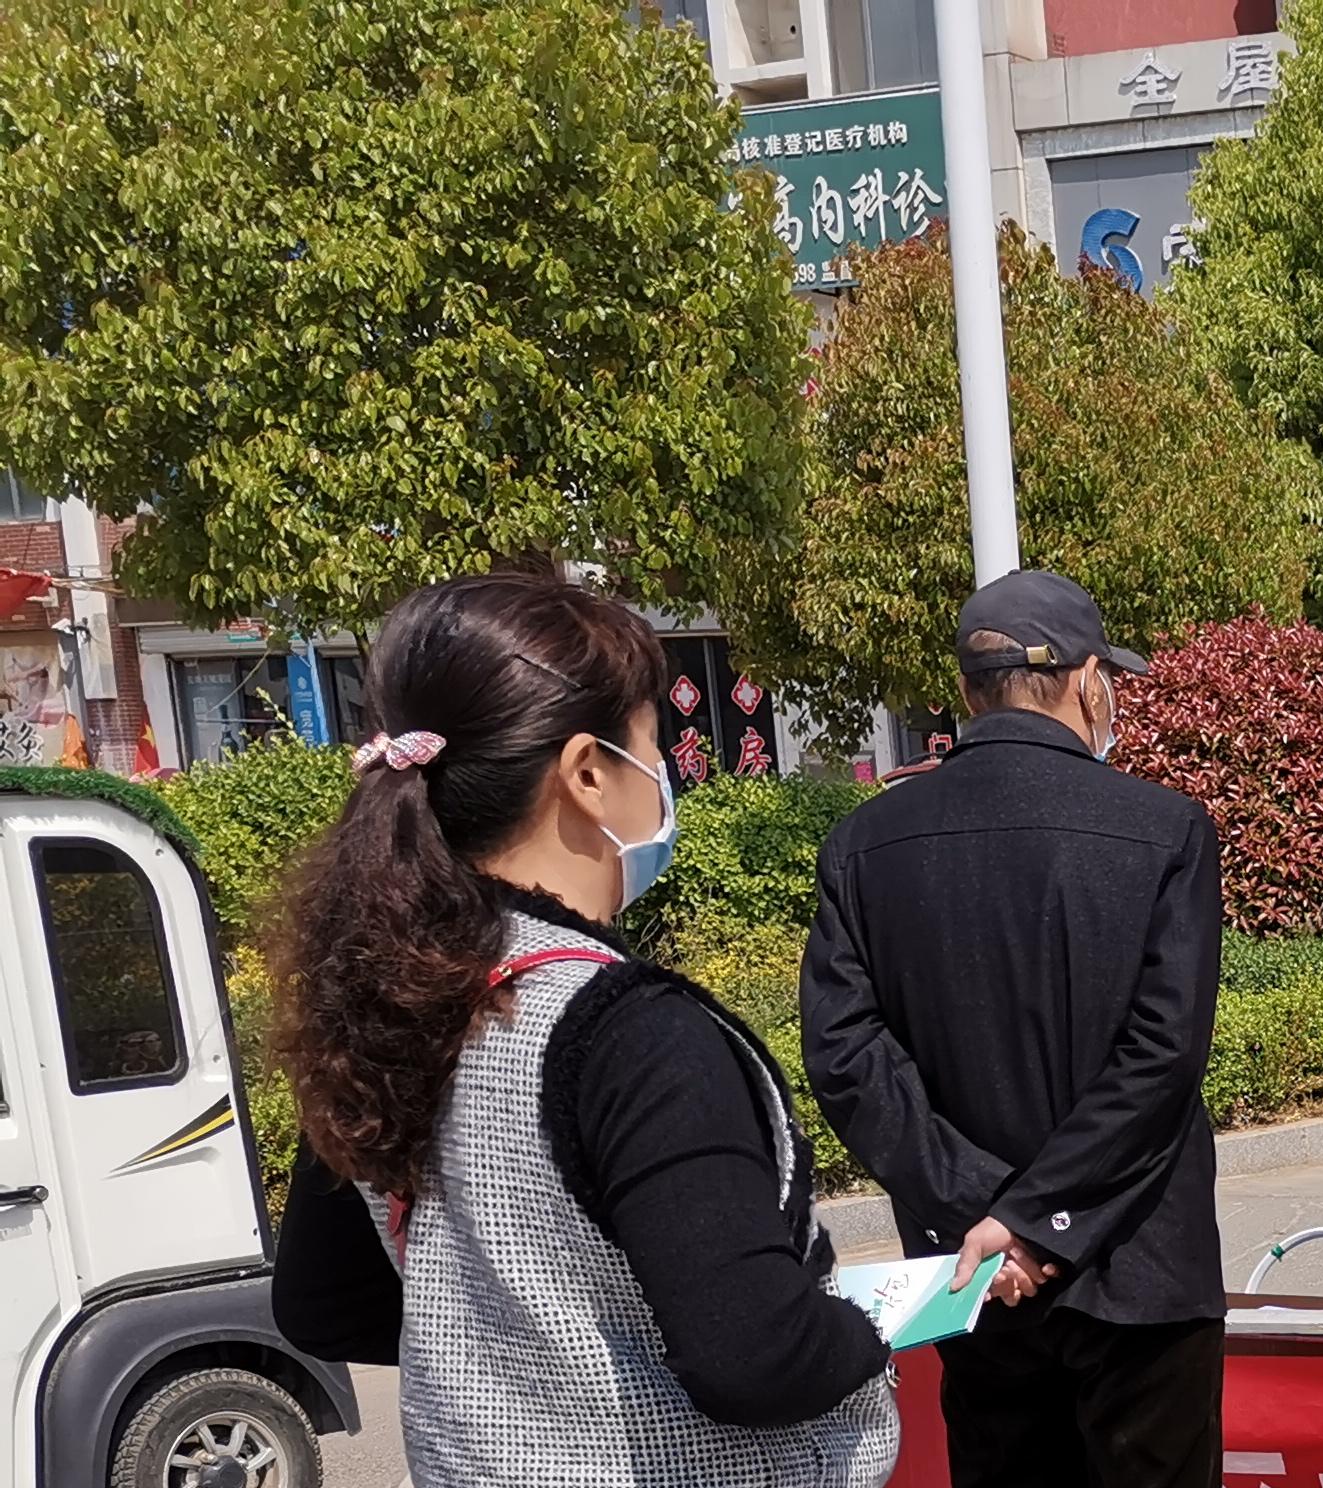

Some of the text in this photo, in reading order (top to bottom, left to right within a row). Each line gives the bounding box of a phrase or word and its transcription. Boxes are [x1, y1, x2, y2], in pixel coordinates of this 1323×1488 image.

[727, 167, 944, 256] 高内科诊
[670, 726, 773, 785] 药房
